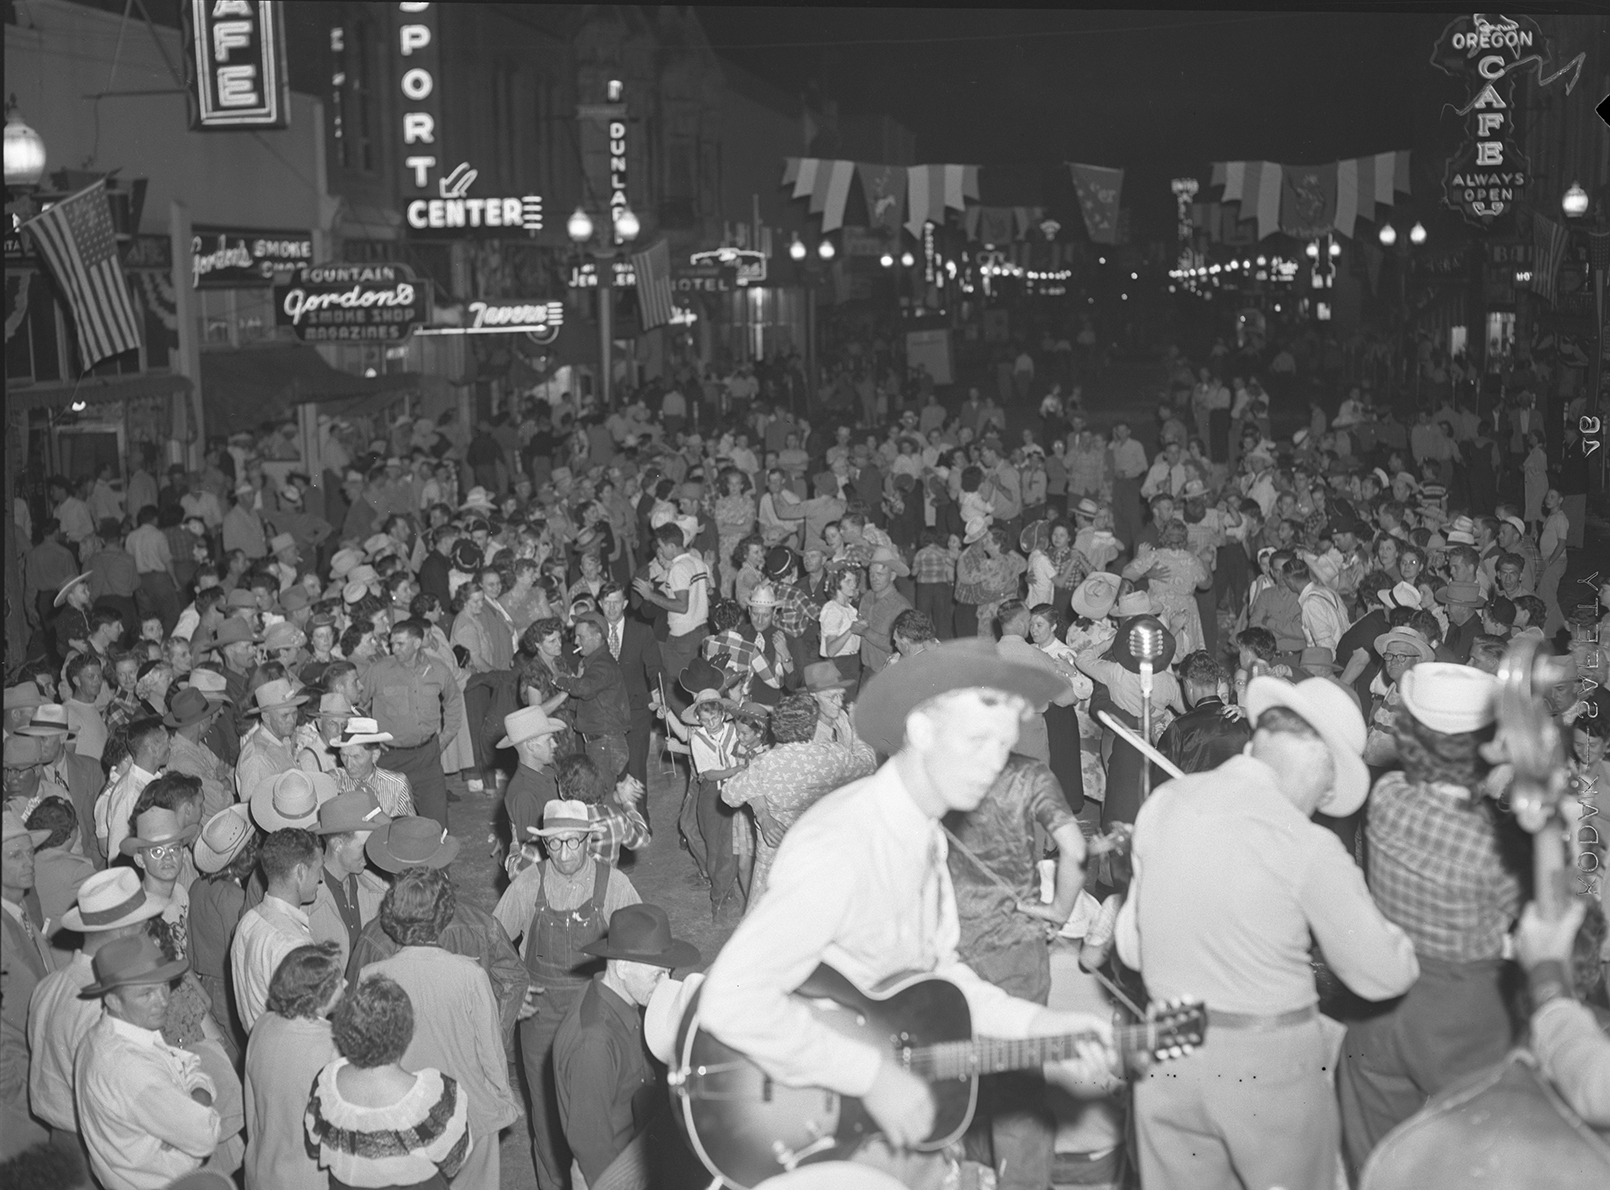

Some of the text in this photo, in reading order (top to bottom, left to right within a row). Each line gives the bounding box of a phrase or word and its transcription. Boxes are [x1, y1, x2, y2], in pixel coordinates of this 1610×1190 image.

[1452, 31, 1533, 49] OREGON
[1452, 173, 1525, 186] ALWAYS
[1464, 188, 1513, 200] OPEN
[407, 199, 524, 228] CENTER
[253, 239, 311, 258] SMOKE
[300, 266, 395, 283] FOUNTAIN
[307, 308, 415, 324] SMOKE SHOP
[305, 325, 399, 340] MAGAZINES
